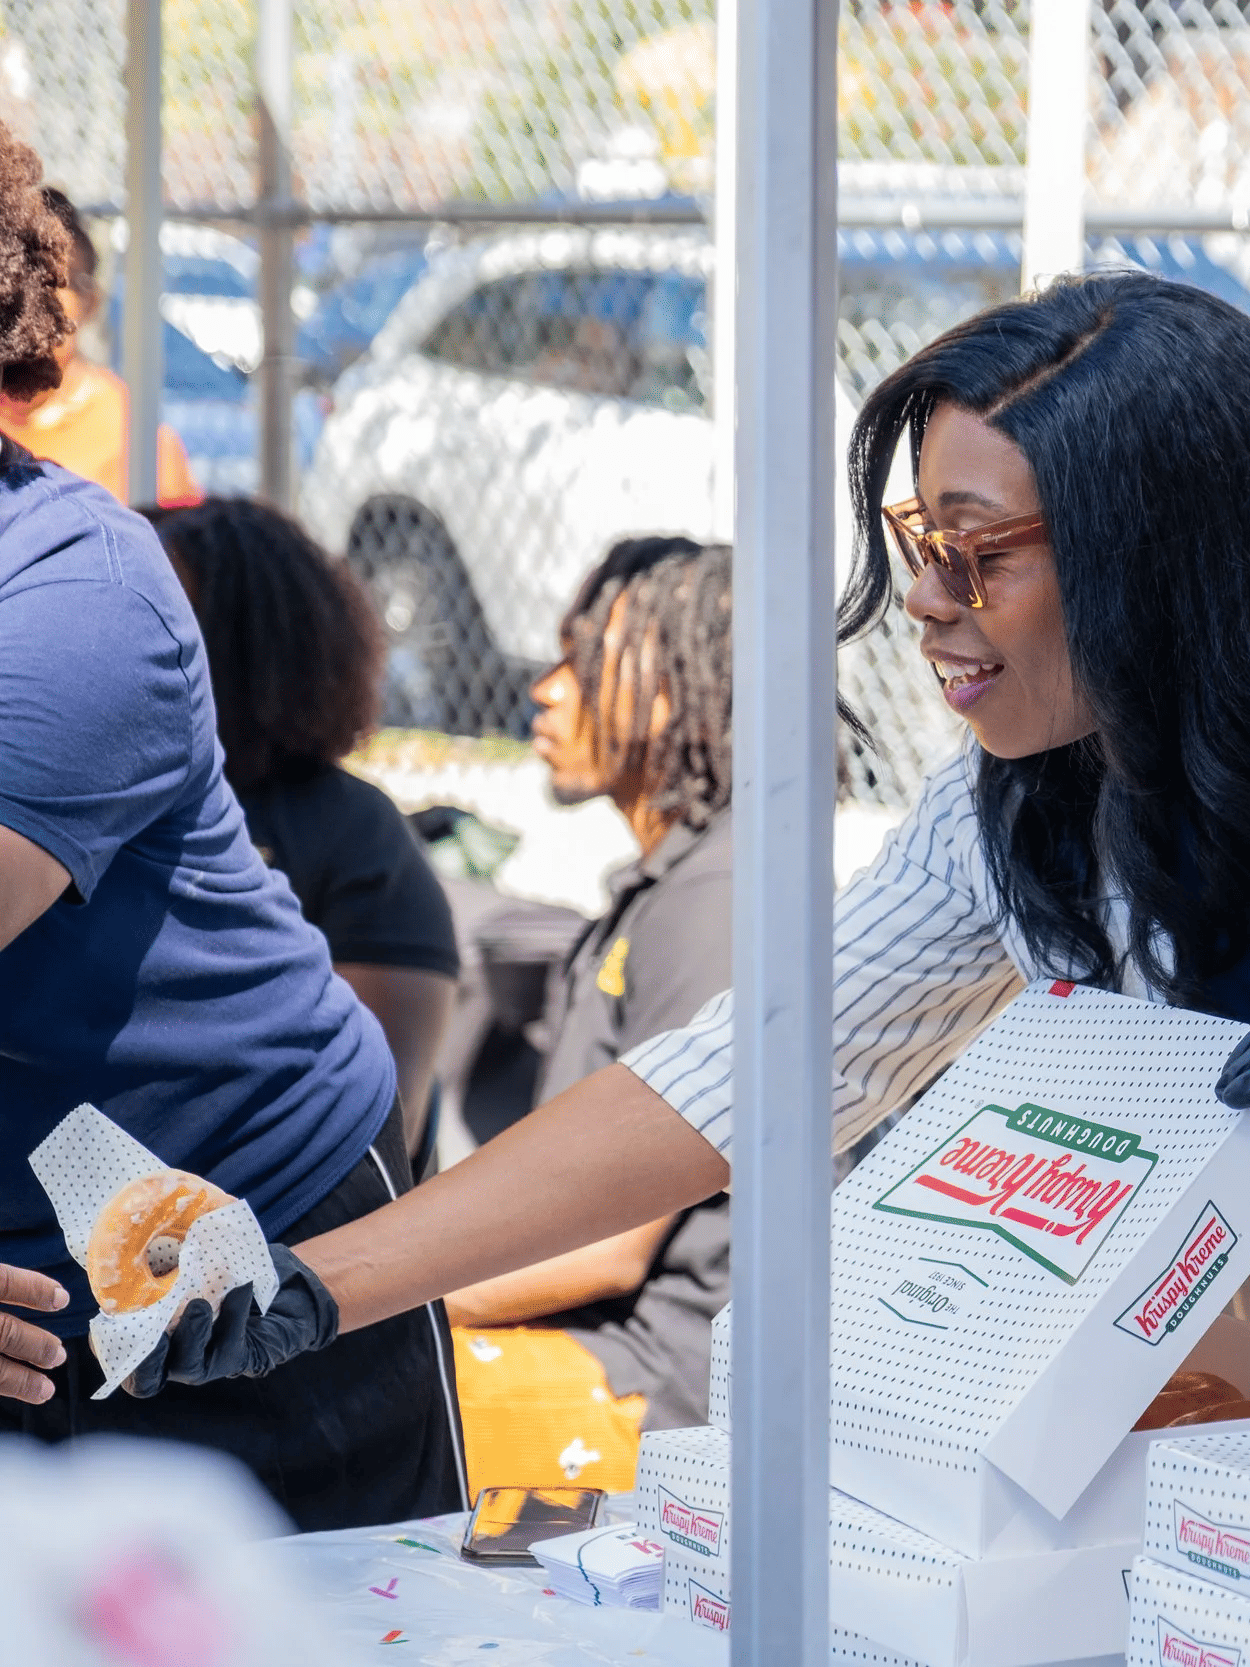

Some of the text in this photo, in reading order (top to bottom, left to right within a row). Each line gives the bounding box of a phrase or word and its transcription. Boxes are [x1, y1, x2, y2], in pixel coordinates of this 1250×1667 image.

[1016, 1109, 1133, 1157] DOUGHNUTS
[914, 1137, 1134, 1246] Krispy Kreme
[891, 1280, 960, 1315] THE Original
[928, 1271, 966, 1291] SINCE 1937
[1134, 1216, 1227, 1338] Krispy Kreme
[1170, 1258, 1225, 1327] DOUGHNUTS
[662, 1499, 719, 1545] Krispy Kreme
[1179, 1516, 1216, 1556] Krispy
[693, 1593, 727, 1631] Krispy
